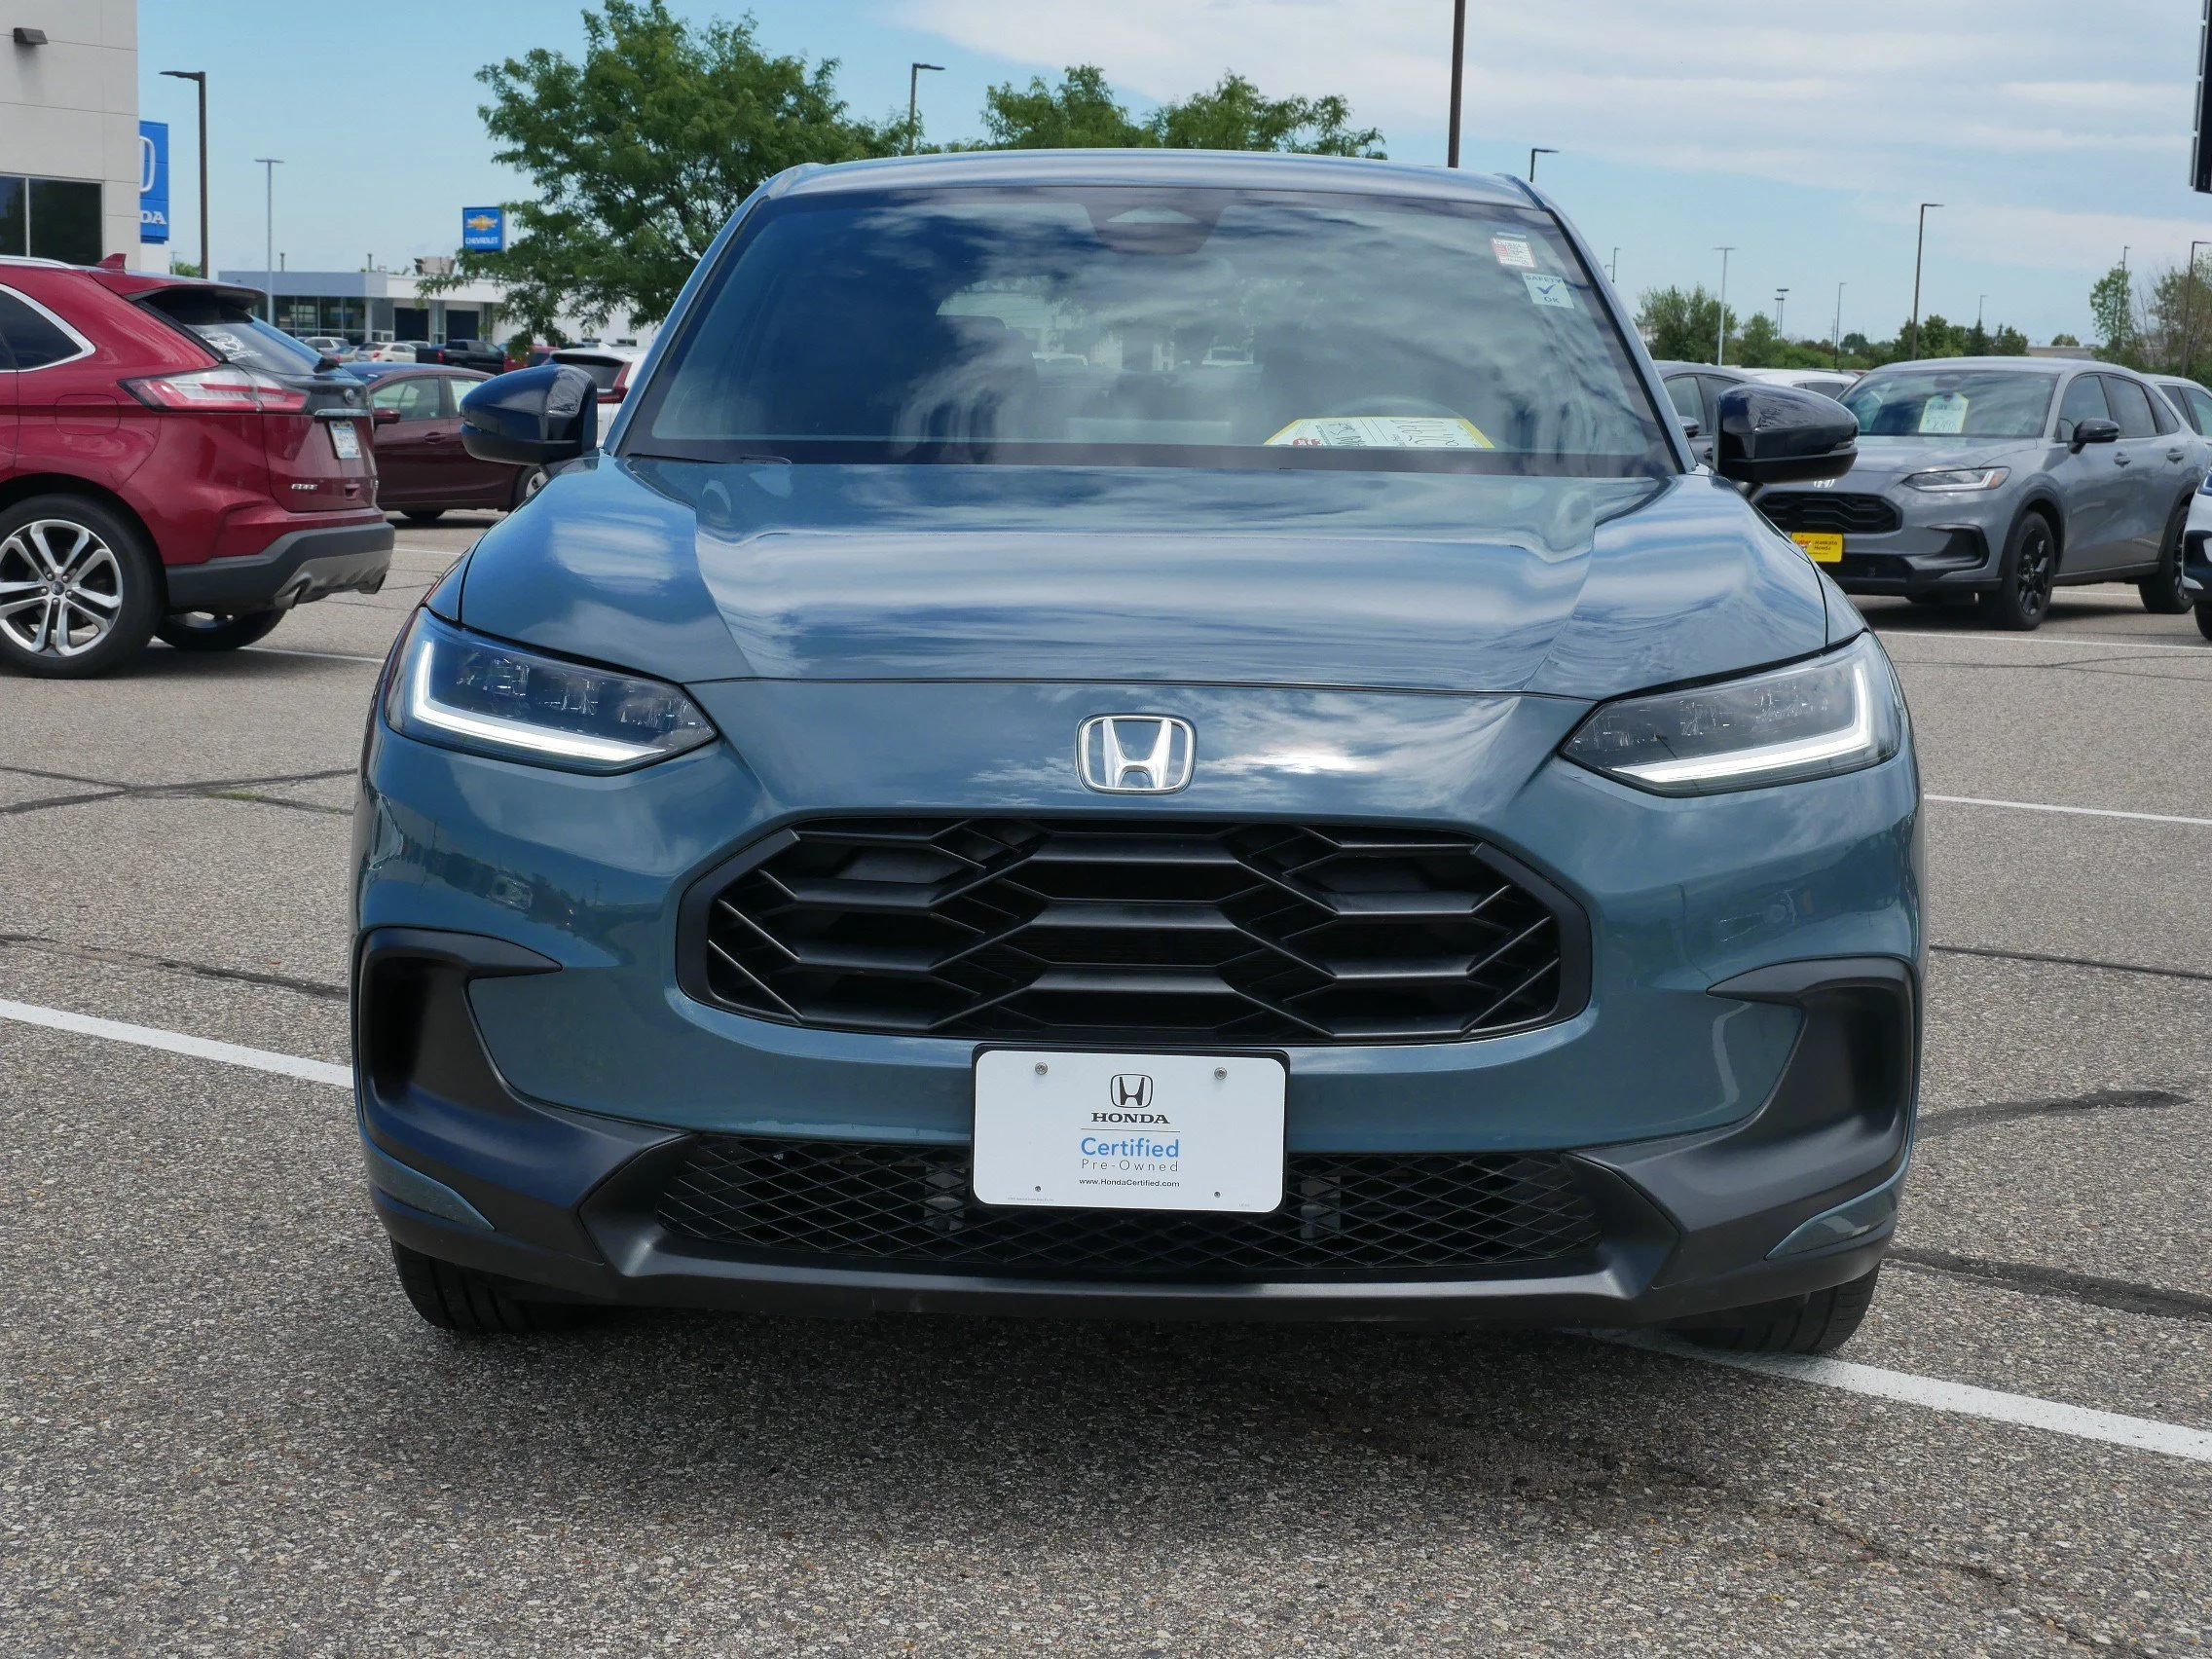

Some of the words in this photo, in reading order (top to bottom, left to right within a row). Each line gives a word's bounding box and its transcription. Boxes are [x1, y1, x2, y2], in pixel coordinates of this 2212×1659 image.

[1525, 275, 1562, 283] SAFETY
[1090, 1112, 1170, 1124] HONDA
[1081, 1137, 1179, 1158] Certified
[1082, 1159, 1178, 1172] Pre-Owned
[1079, 1178, 1180, 1188] www.HondaCertified.com
